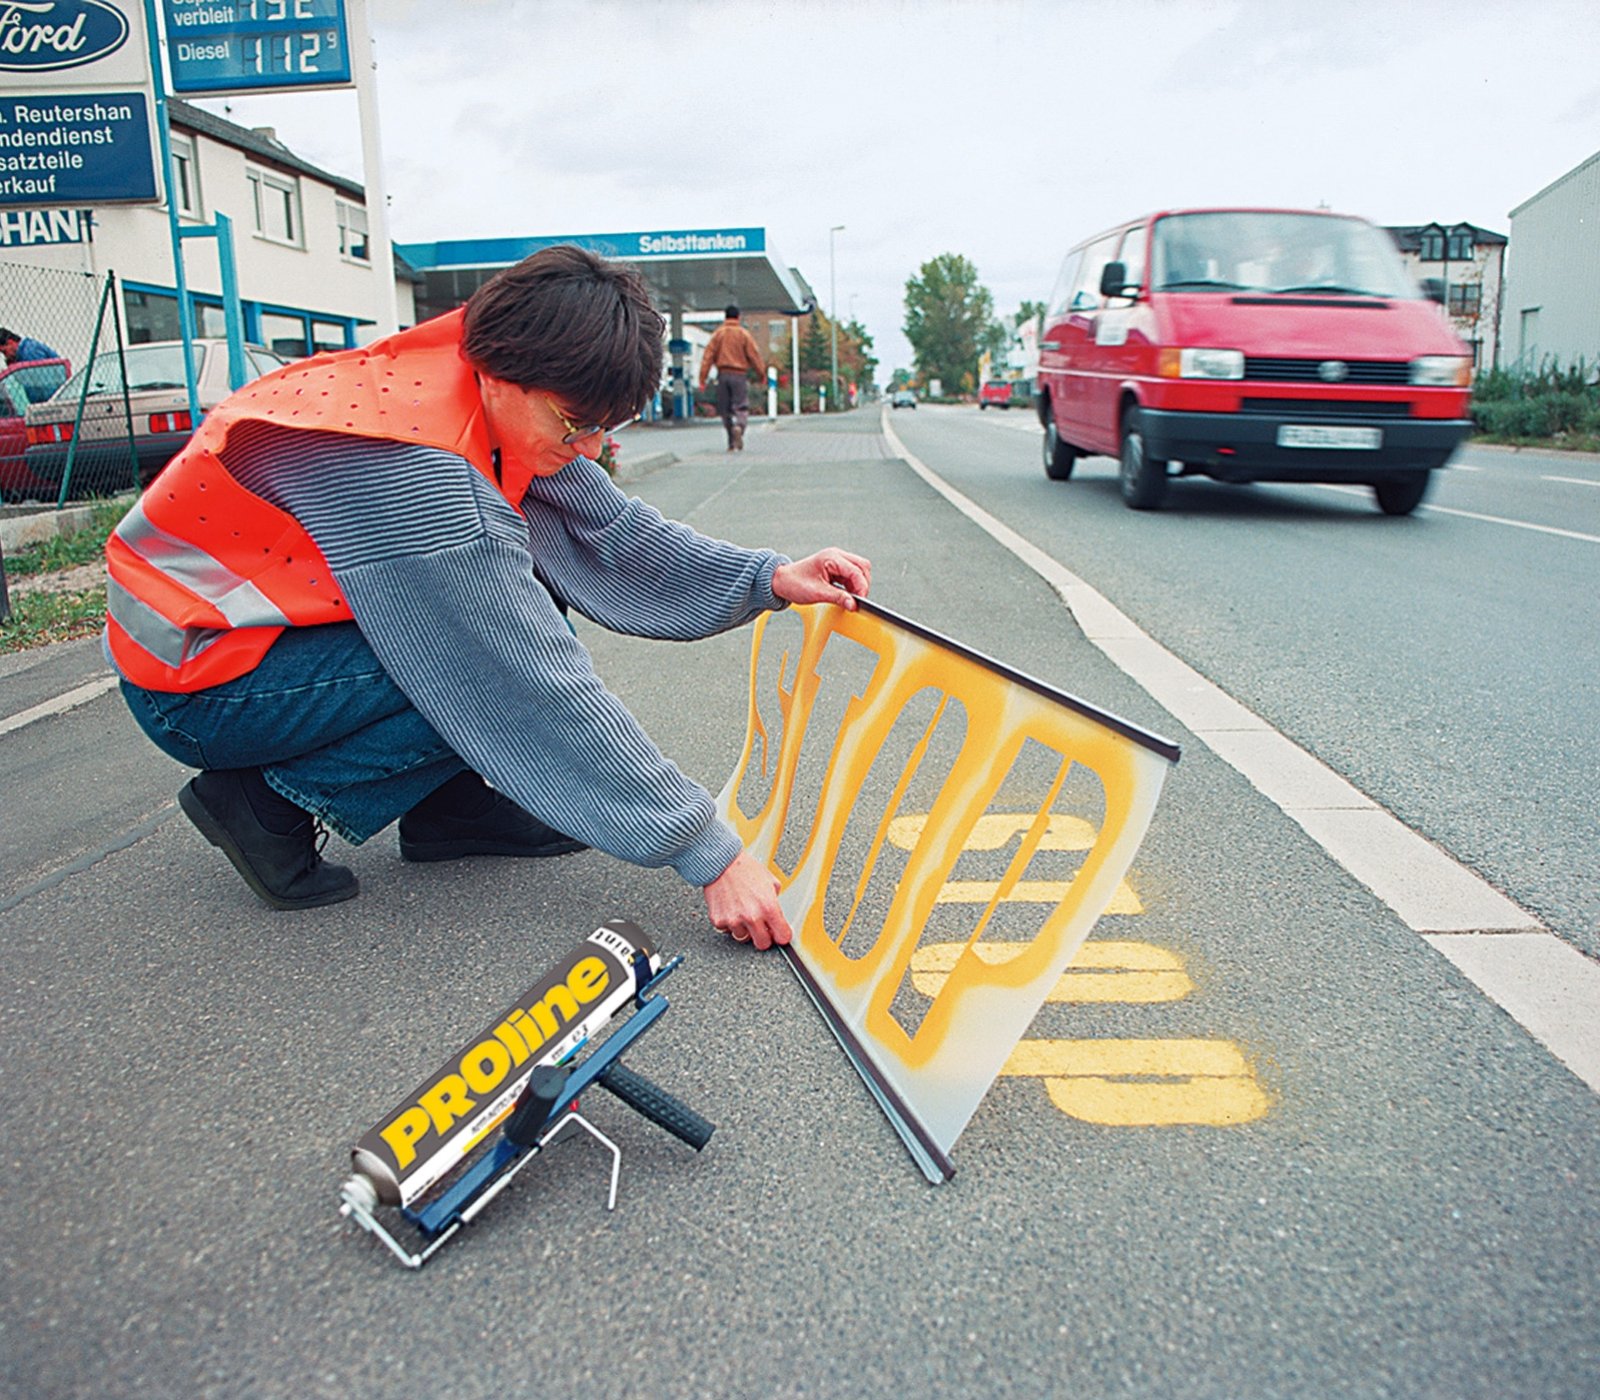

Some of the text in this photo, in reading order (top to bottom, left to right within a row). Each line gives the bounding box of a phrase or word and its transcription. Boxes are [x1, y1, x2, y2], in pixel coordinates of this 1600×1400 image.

[0, 0, 87, 53] Ford
[173, 7, 235, 26] verbleit
[177, 41, 230, 62] Diesel
[15, 103, 132, 123] Reutershan
[0, 126, 113, 147] ndendienst
[0, 209, 80, 245] HAN
[639, 233, 746, 253] Selbsttanken
[736, 608, 1107, 1041] STOP
[379, 956, 610, 1170] PROline
